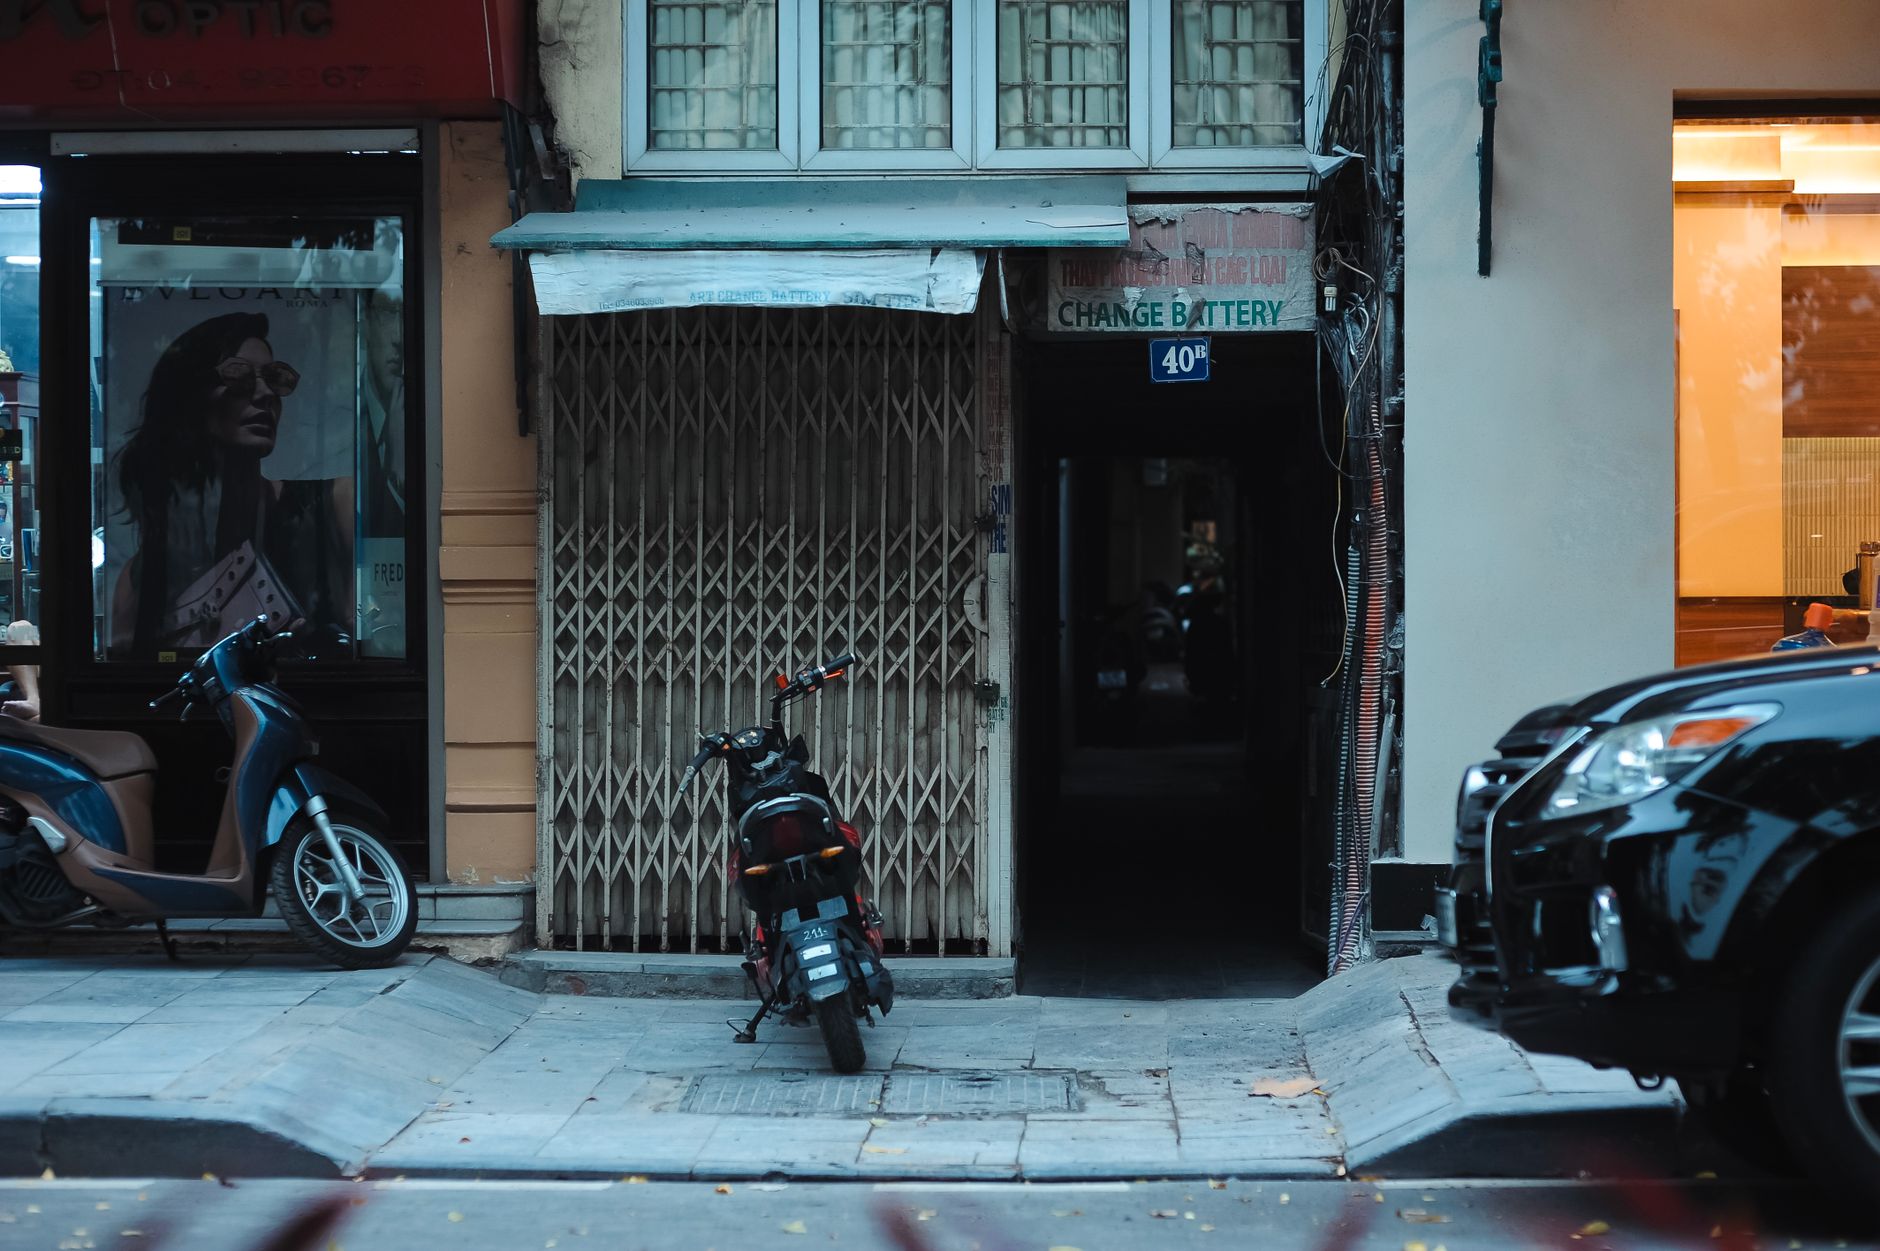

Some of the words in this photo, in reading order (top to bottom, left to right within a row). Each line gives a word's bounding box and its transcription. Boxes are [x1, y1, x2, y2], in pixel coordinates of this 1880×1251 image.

[134, 0, 334, 38] OPTIC
[286, 300, 329, 308] ROMA
[690, 291, 714, 303] ART
[718, 290, 768, 303] CHANGE
[771, 290, 830, 303] BATTERY
[1058, 301, 1163, 327] CHANGE
[992, 485, 1010, 515] SIM
[374, 563, 404, 586] FRED
